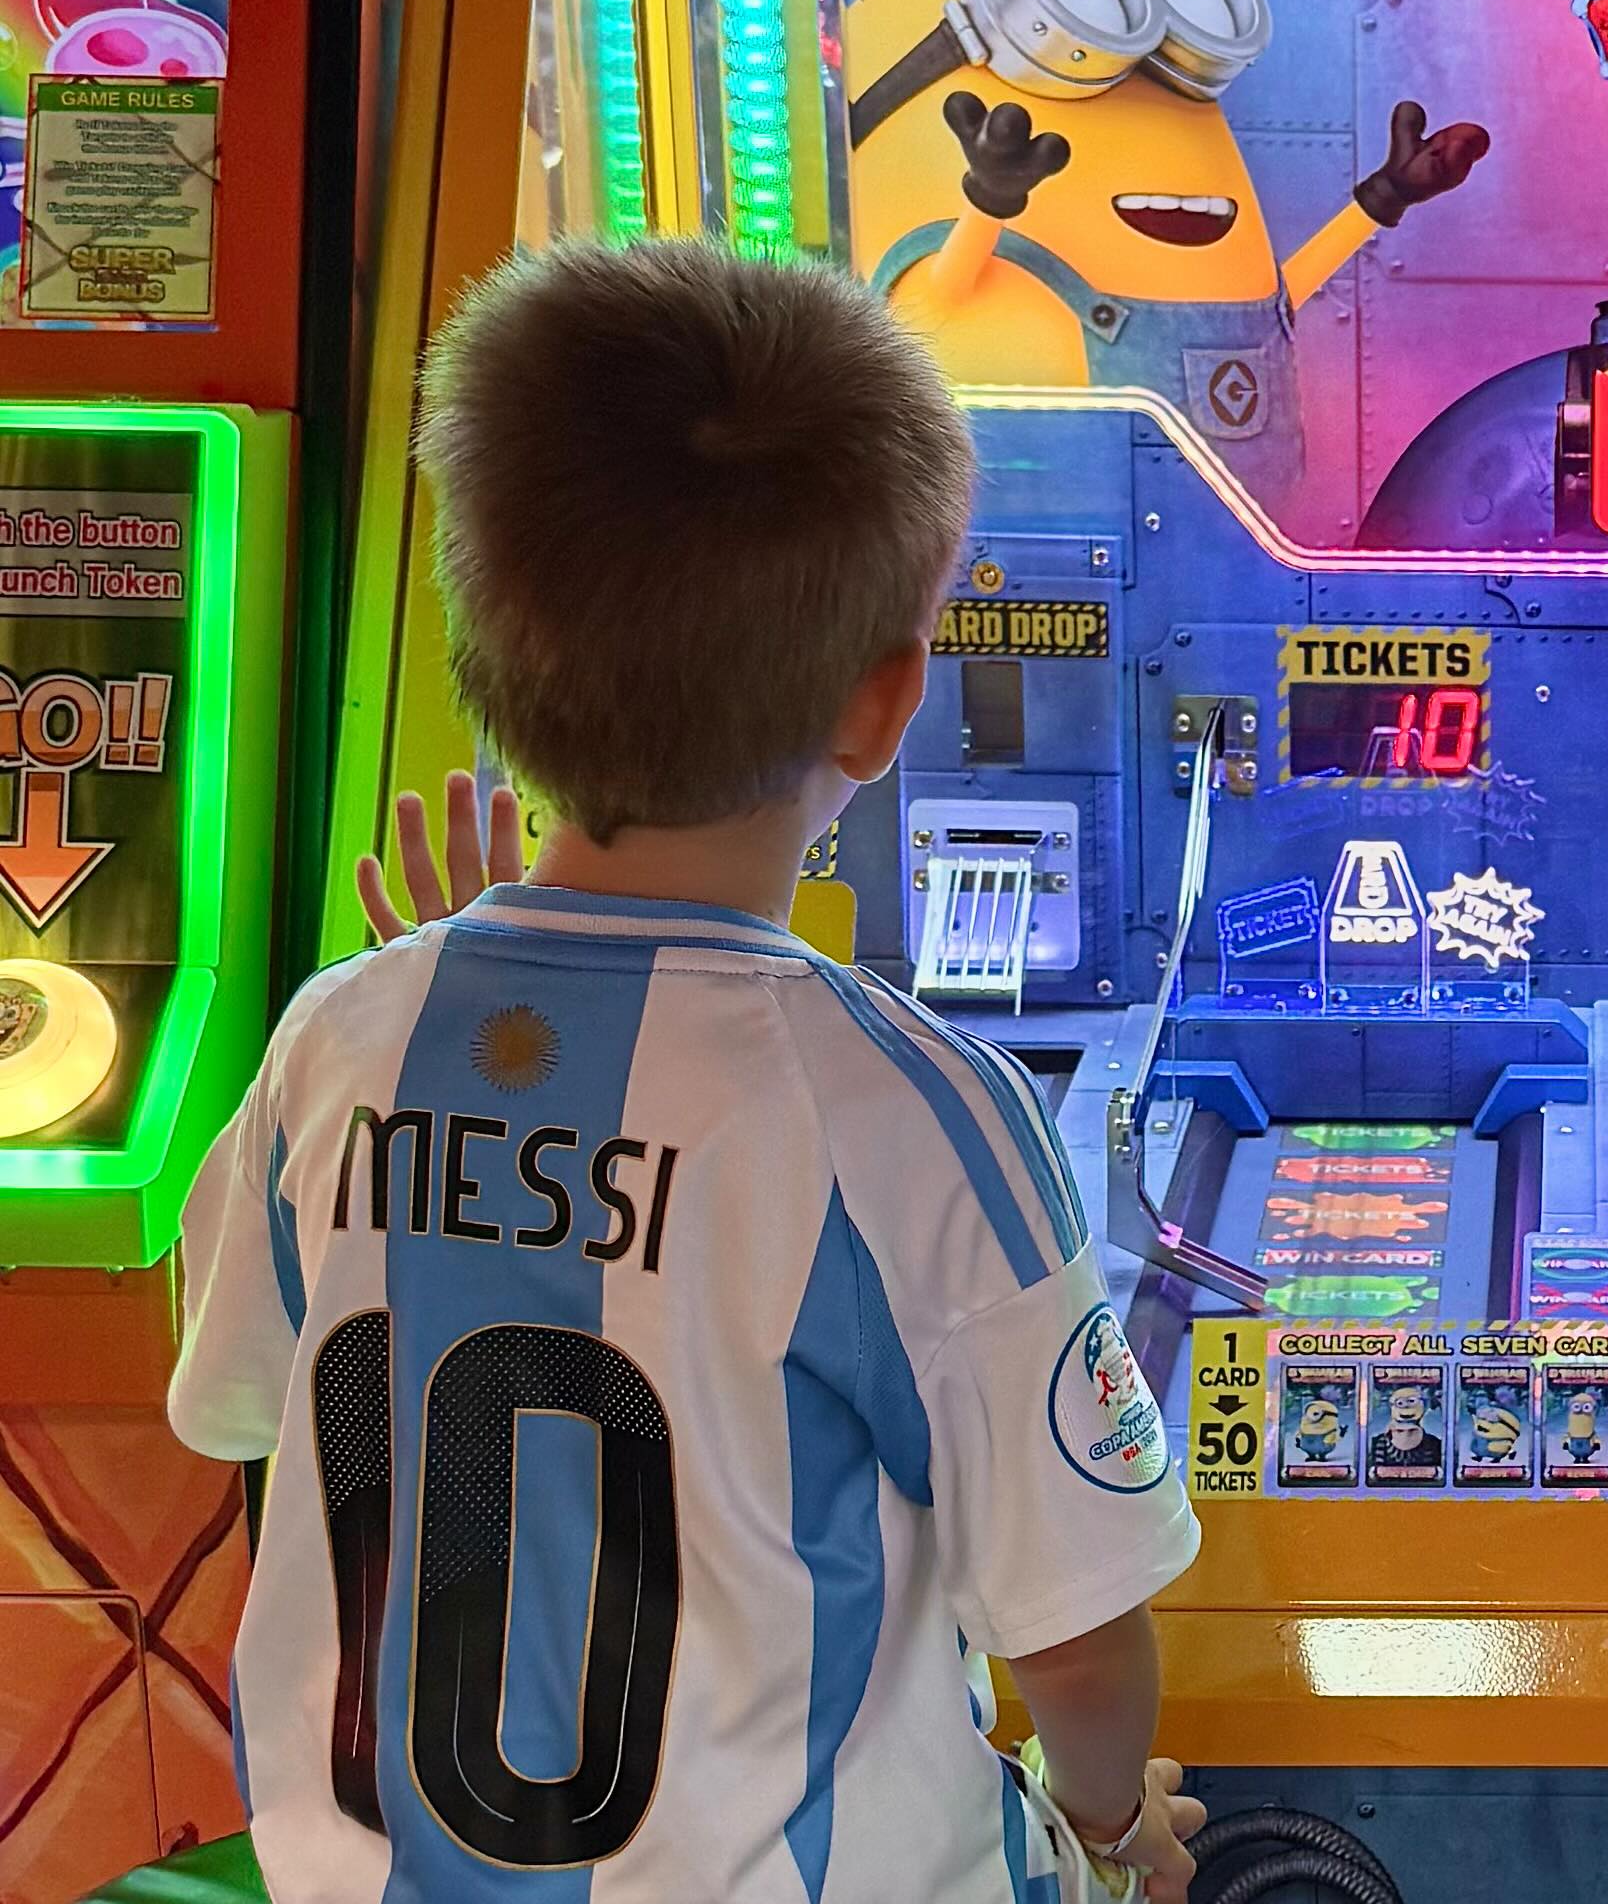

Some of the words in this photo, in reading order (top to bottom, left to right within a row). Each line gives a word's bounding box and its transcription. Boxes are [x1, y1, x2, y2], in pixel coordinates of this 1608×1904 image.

[61, 90, 121, 108] GAME
[128, 92, 195, 109] RULES
[20, 511, 74, 545] the
[80, 512, 181, 547] button
[0, 563, 78, 597] unch
[84, 562, 182, 598] Token
[936, 609, 1004, 645] ARD
[1009, 611, 1098, 647] DROP
[1296, 640, 1471, 678] TICKETS
[1393, 690, 1480, 770] 10
[1231, 904, 1306, 942] TICKET
[1329, 915, 1418, 943] DROP
[1310, 1163, 1424, 1175] TICKETS
[331, 1104, 681, 1276] MESSI
[1298, 1209, 1417, 1221] TICKETS
[1267, 1252, 1335, 1264] WIN
[1342, 1252, 1428, 1265] CARD
[1284, 1289, 1406, 1301] TICKETS
[1223, 1332, 1238, 1363] 1
[1279, 1334, 1396, 1356] COLLECT
[1402, 1335, 1453, 1356] ALL
[1462, 1335, 1546, 1356] SEVEN
[1198, 1367, 1260, 1387] CARD
[1195, 1422, 1259, 1466] 50
[1195, 1470, 1257, 1492] TICKETS
[310, 1306, 684, 1870] 10
